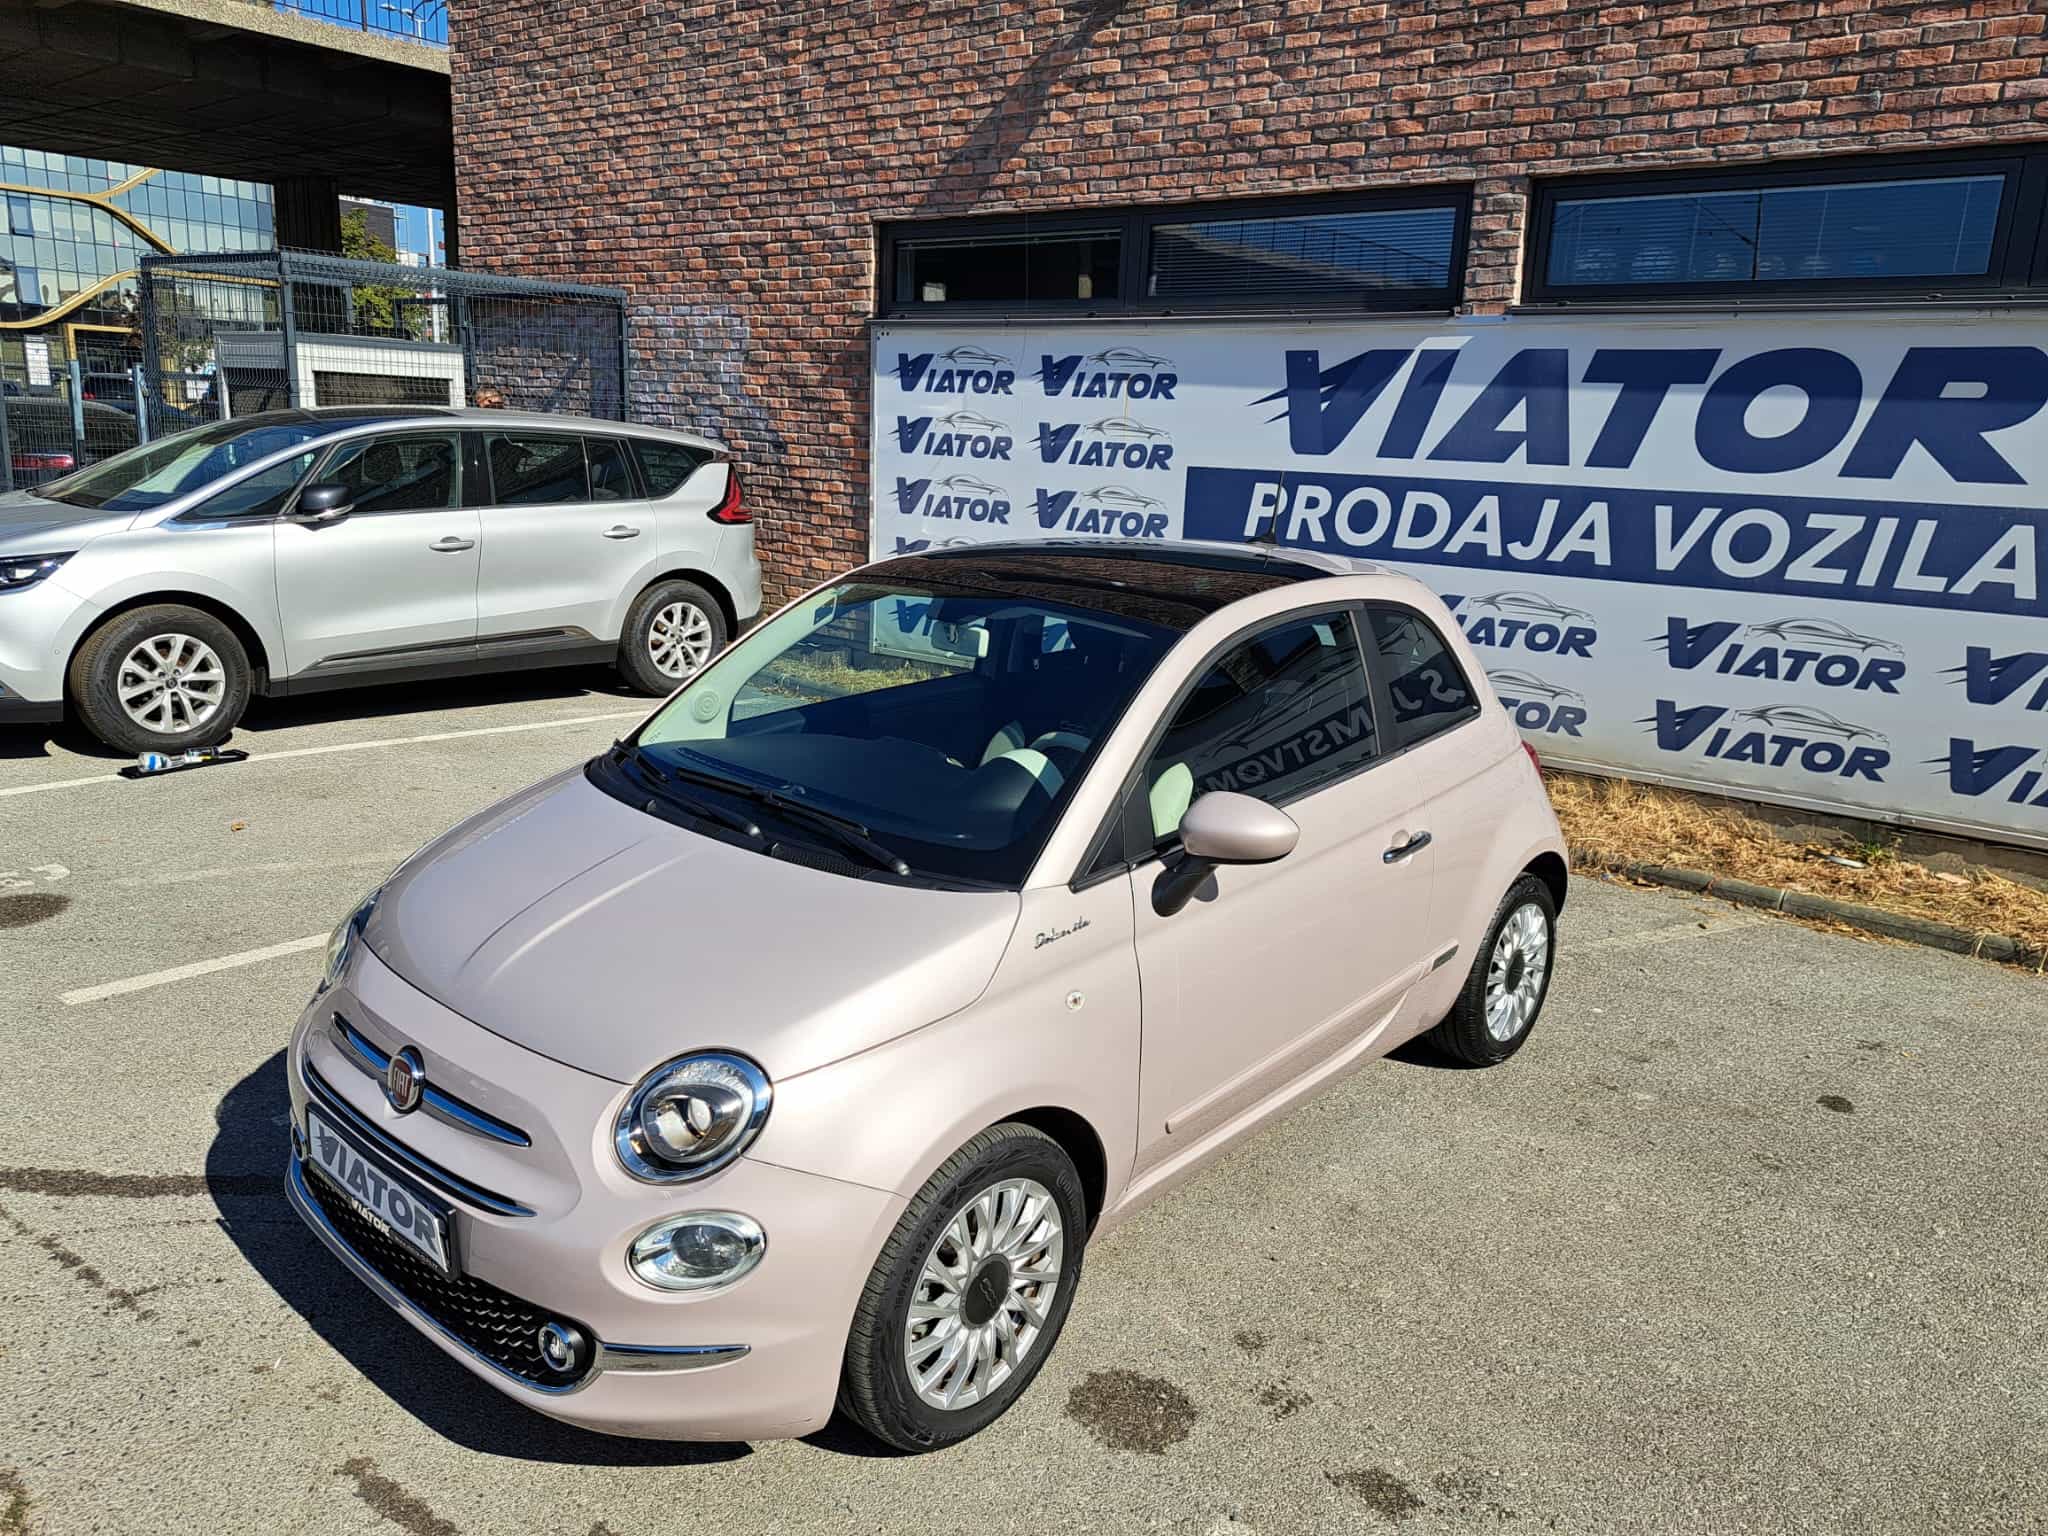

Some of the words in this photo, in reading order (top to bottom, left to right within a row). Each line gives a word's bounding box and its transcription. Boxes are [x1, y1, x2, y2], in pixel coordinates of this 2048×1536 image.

[889, 353, 1015, 396] VIATOR
[1033, 355, 1178, 400] VIATOR
[889, 415, 1013, 461] VIATOR
[1252, 345, 2048, 485] VIATOR
[1028, 422, 1174, 470] VIATOR
[889, 476, 1010, 525] VIATOR
[1028, 488, 1169, 538] VIATOR
[1243, 483, 1612, 566] PRODAJA
[1654, 504, 2038, 600] VOZILA
[1645, 616, 1907, 695] VIATOR
[1635, 699, 1891, 782] VIATOR
[313, 1123, 442, 1257] VIATOR
[351, 1198, 391, 1238] VIATOR
